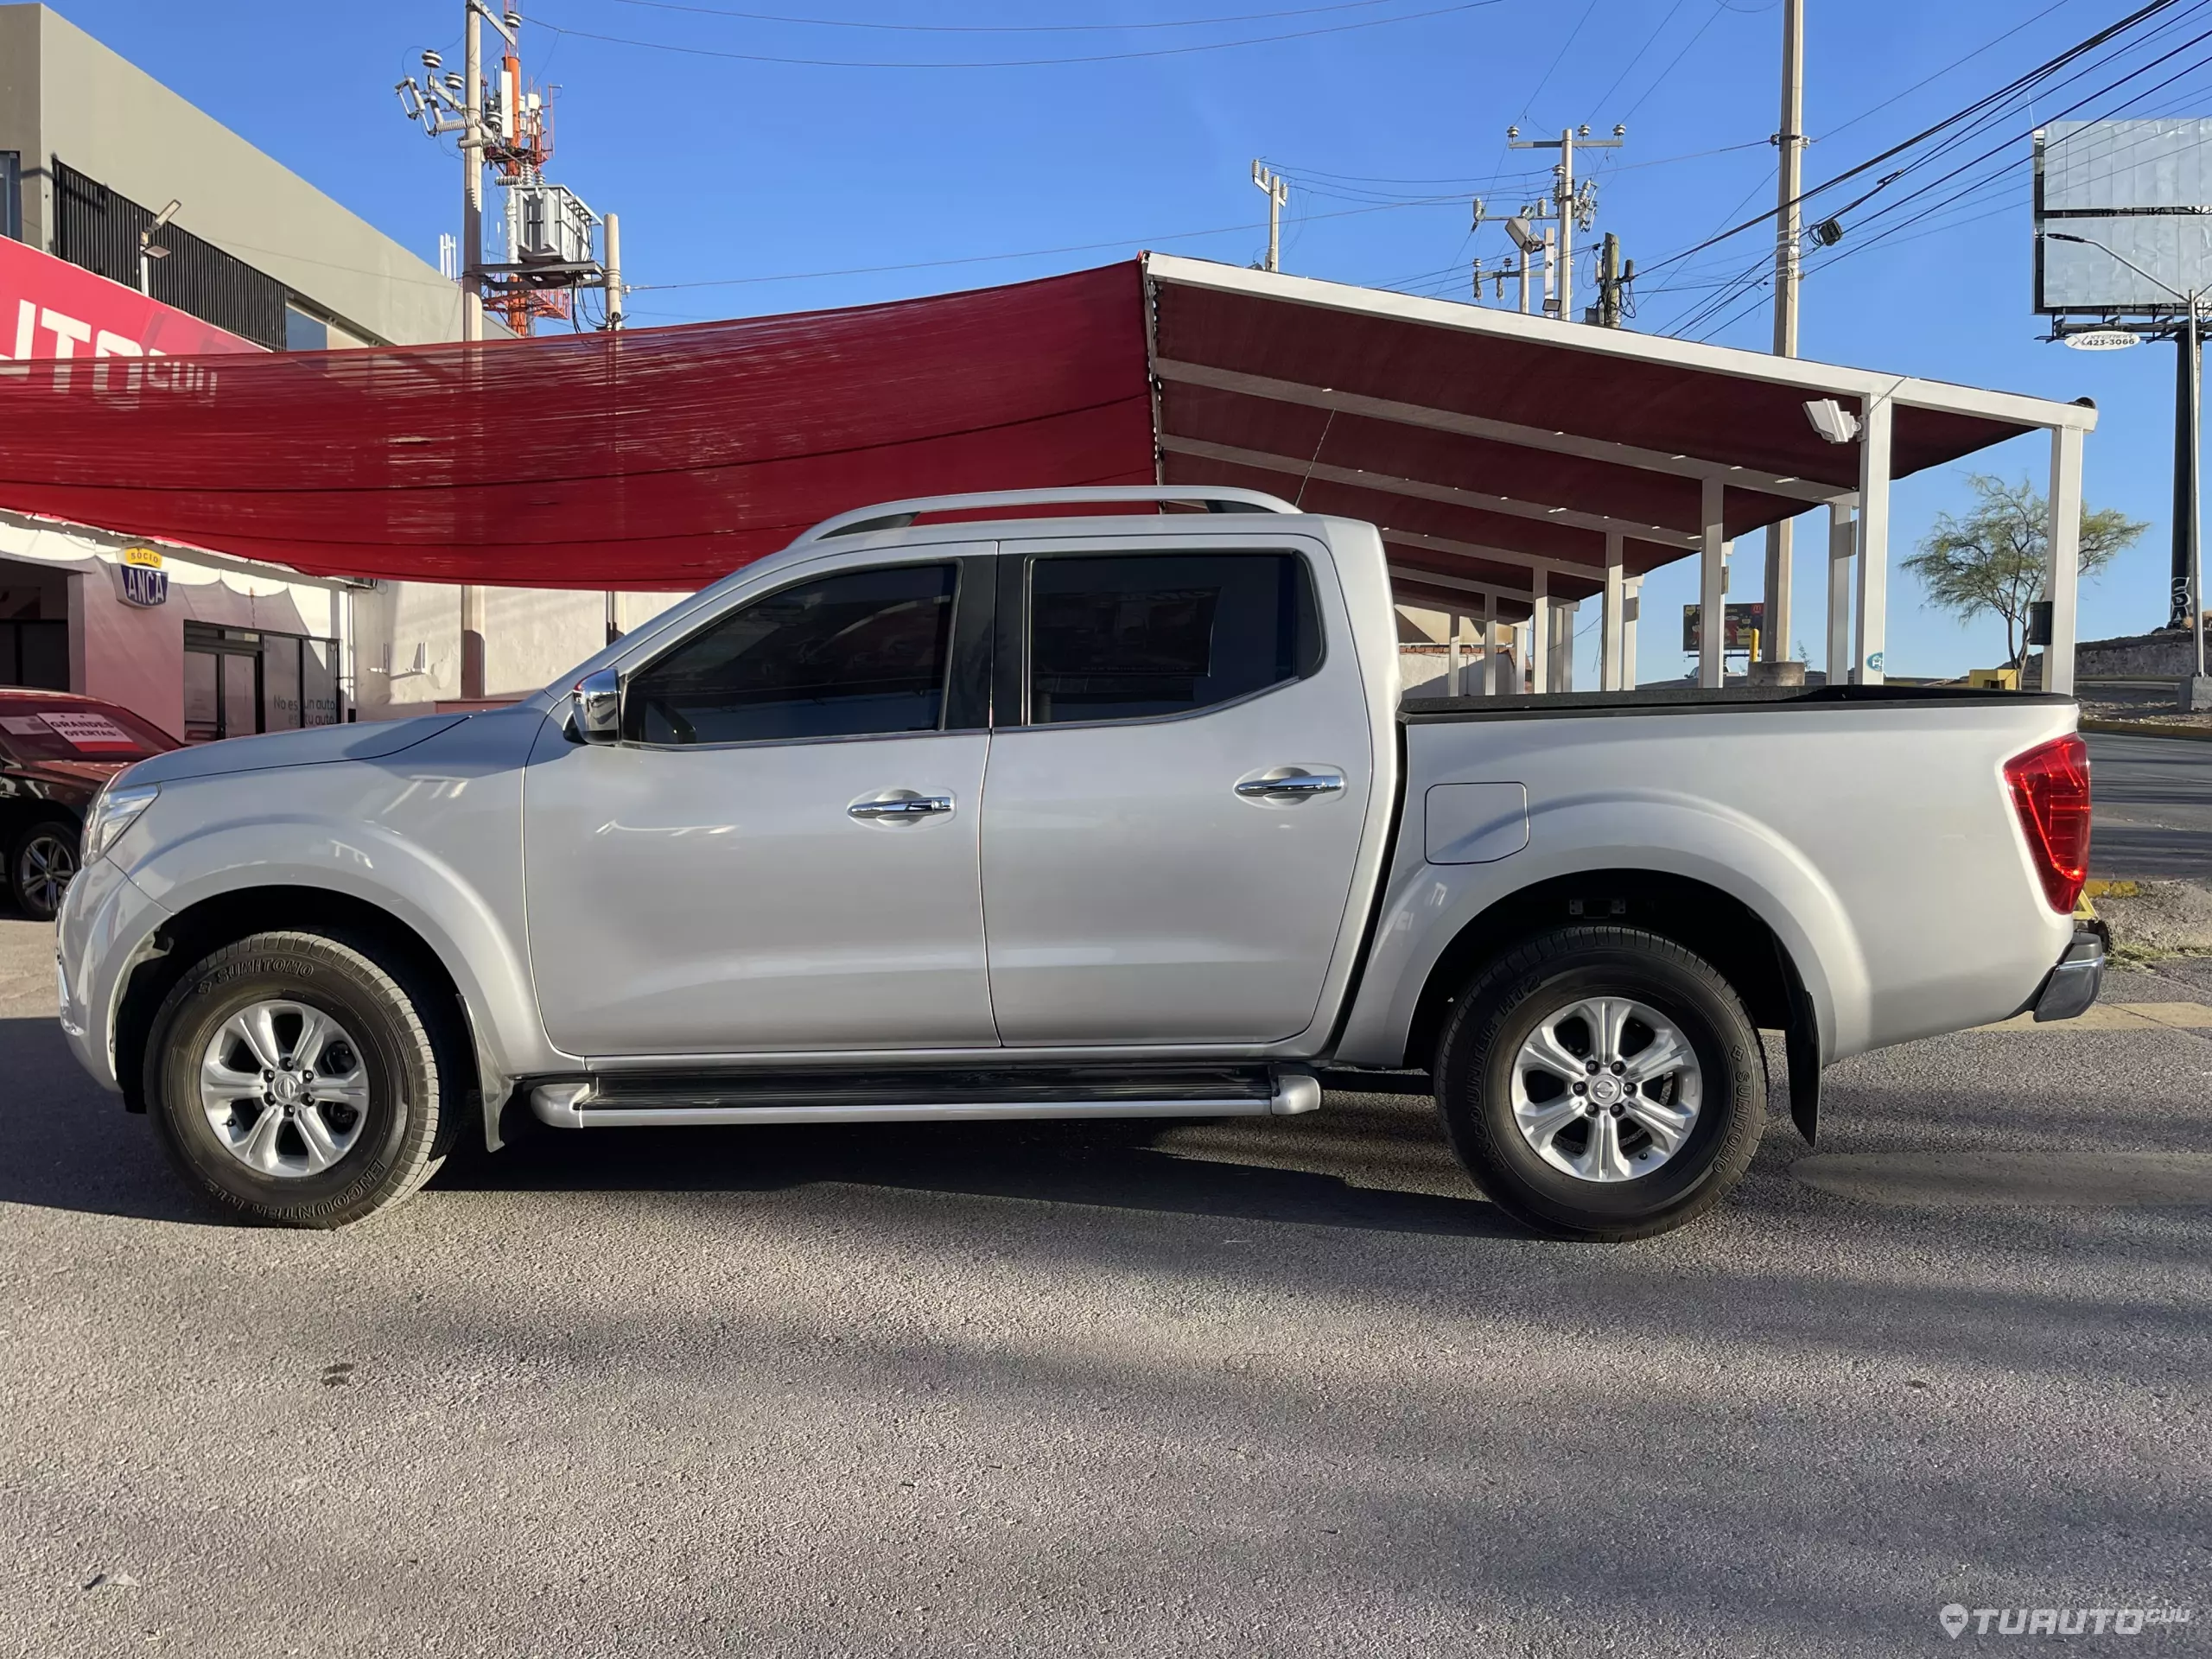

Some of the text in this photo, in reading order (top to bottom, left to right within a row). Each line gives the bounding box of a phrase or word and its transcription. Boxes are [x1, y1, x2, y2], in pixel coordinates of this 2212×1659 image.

[2086, 338, 2135, 346] 423-3066
[128, 569, 164, 604] ANCA
[273, 695, 286, 710] No
[288, 700, 299, 711] es
[316, 698, 336, 710] auto
[217, 957, 315, 983] SUMITOMO
[1467, 1019, 1506, 1172] ENCOUNTER
[1713, 1071, 1751, 1173] SUMITOMO
[252, 1158, 387, 1220] ENCOUNTER
